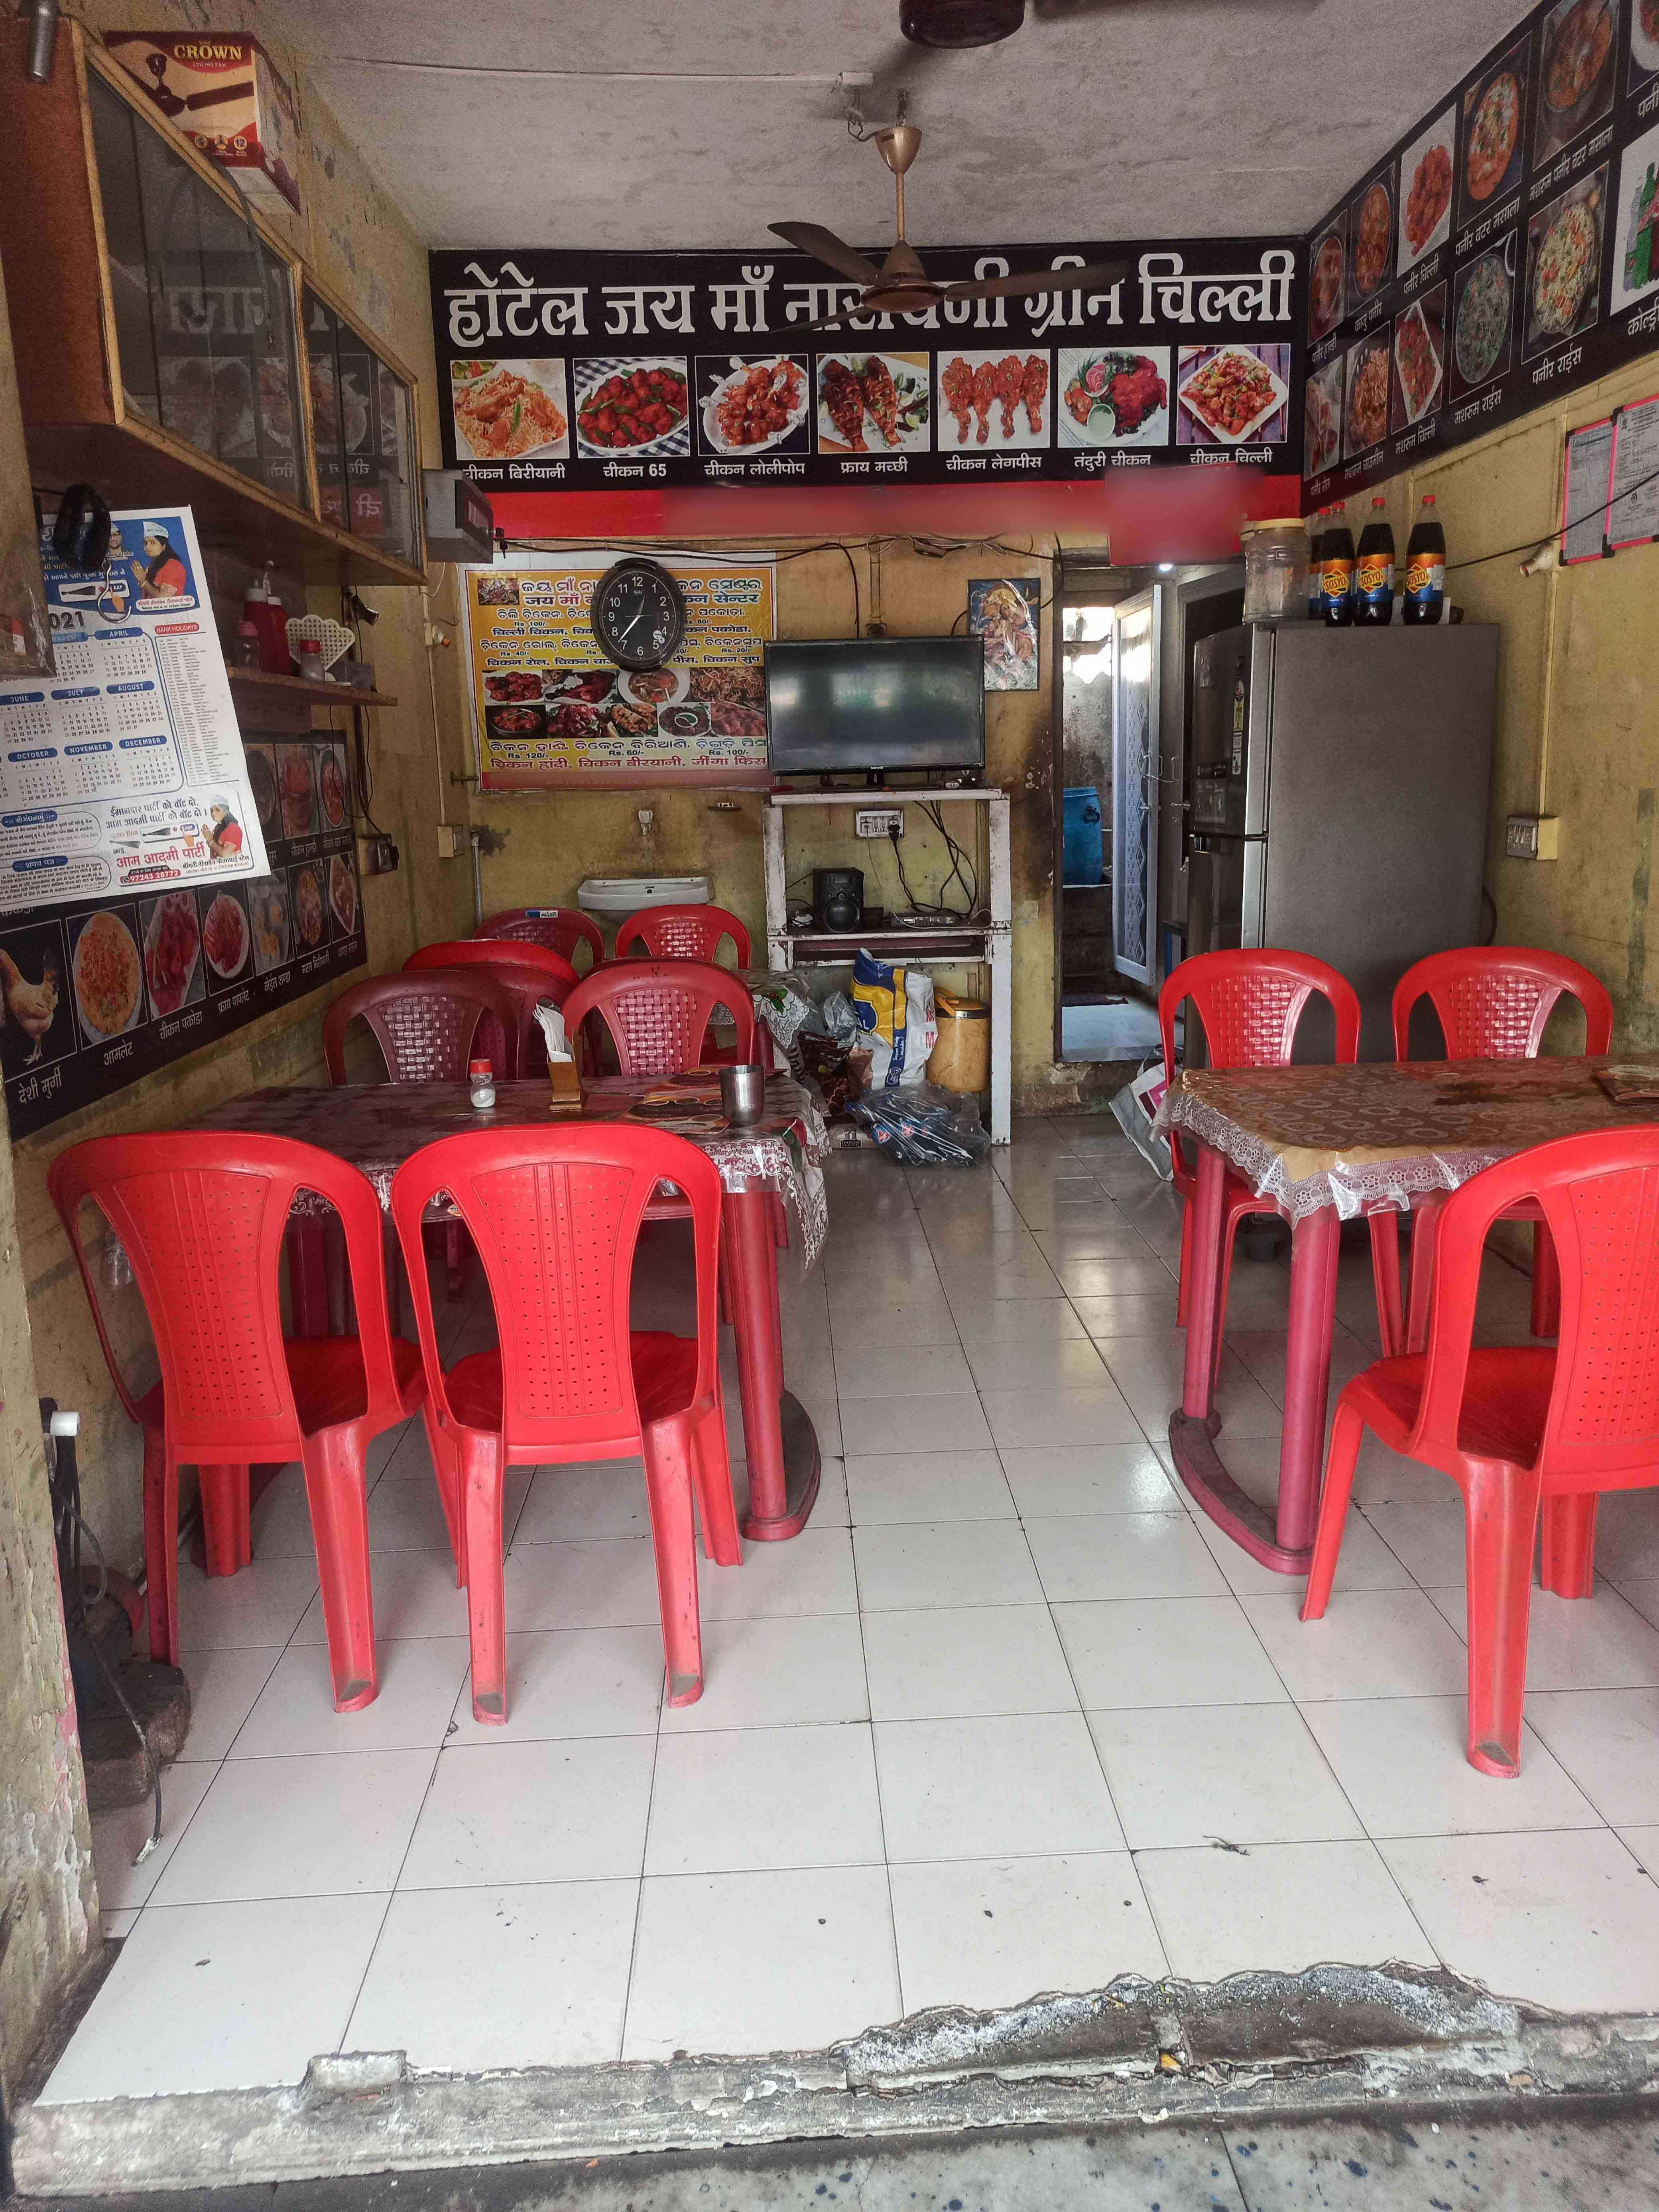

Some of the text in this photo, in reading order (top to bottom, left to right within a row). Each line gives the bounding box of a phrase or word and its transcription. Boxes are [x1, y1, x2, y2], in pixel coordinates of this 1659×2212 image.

[173, 45, 242, 60] CROWN
[1638, 82, 1659, 118] पनी
[1456, 230, 1474, 256] पनीर
[1493, 196, 1521, 228] मसाला
[1404, 254, 1439, 294] पनीर चिल्ली
[444, 261, 589, 348] होटेल
[601, 285, 695, 335] जय
[708, 265, 774, 333] माँ
[1137, 250, 1295, 324] चिल्ली
[1368, 299, 1383, 321] पनीर
[1532, 342, 1583, 385] पनीर राईस
[1454, 401, 1480, 425] मशरुम
[1417, 417, 1436, 445] चिल्ली
[946, 453, 1043, 471] चीकन लेगपीस
[1074, 451, 1151, 471] तंदुरी चीकन
[1189, 449, 1273, 464] चीकन चिल्ली
[508, 462, 566, 479] बिरीयानी
[603, 462, 667, 478] चीकन 65
[704, 459, 806, 476] चीकन लोलीपोप
[840, 457, 909, 474] फ्राय मच्छी
[632, 576, 644, 587] 12
[1324, 577, 1346, 591] SOSYO
[1361, 571, 1381, 586] SOSYO
[1407, 571, 1427, 586] SOSYO
[618, 583, 628, 594] 11
[652, 583, 656, 594] 1
[525, 596, 555, 606] जय
[559, 592, 580, 605] माँ
[609, 597, 621, 607] 10
[660, 596, 667, 606] 2
[713, 591, 759, 603] सेन्टर
[50, 611, 85, 630] 021
[608, 612, 615, 622] 9
[663, 611, 670, 621] 3
[492, 627, 525, 636] चिल्ली
[612, 626, 618, 637] 8
[661, 626, 668, 637] 4
[621, 640, 628, 650] 7
[637, 645, 644, 656] 6
[653, 640, 659, 649] 5
[487, 658, 522, 667] चिकन
[555, 657, 589, 665] चिकन
[69, 744, 108, 754] NOVEMBER
[124, 738, 161, 747] DECEMBER
[16, 751, 49, 760] OCTOBER
[490, 758, 533, 769] चिकन
[578, 758, 622, 768] चिकन
[116, 840, 205, 869] आम आदमी पार्टी
[130, 872, 154, 884] 97243
[159, 1009, 203, 1040] चीकन पकोडा
[103, 1038, 134, 1066] आमलेट
[19, 1065, 62, 1104] देशी मुर्गी
